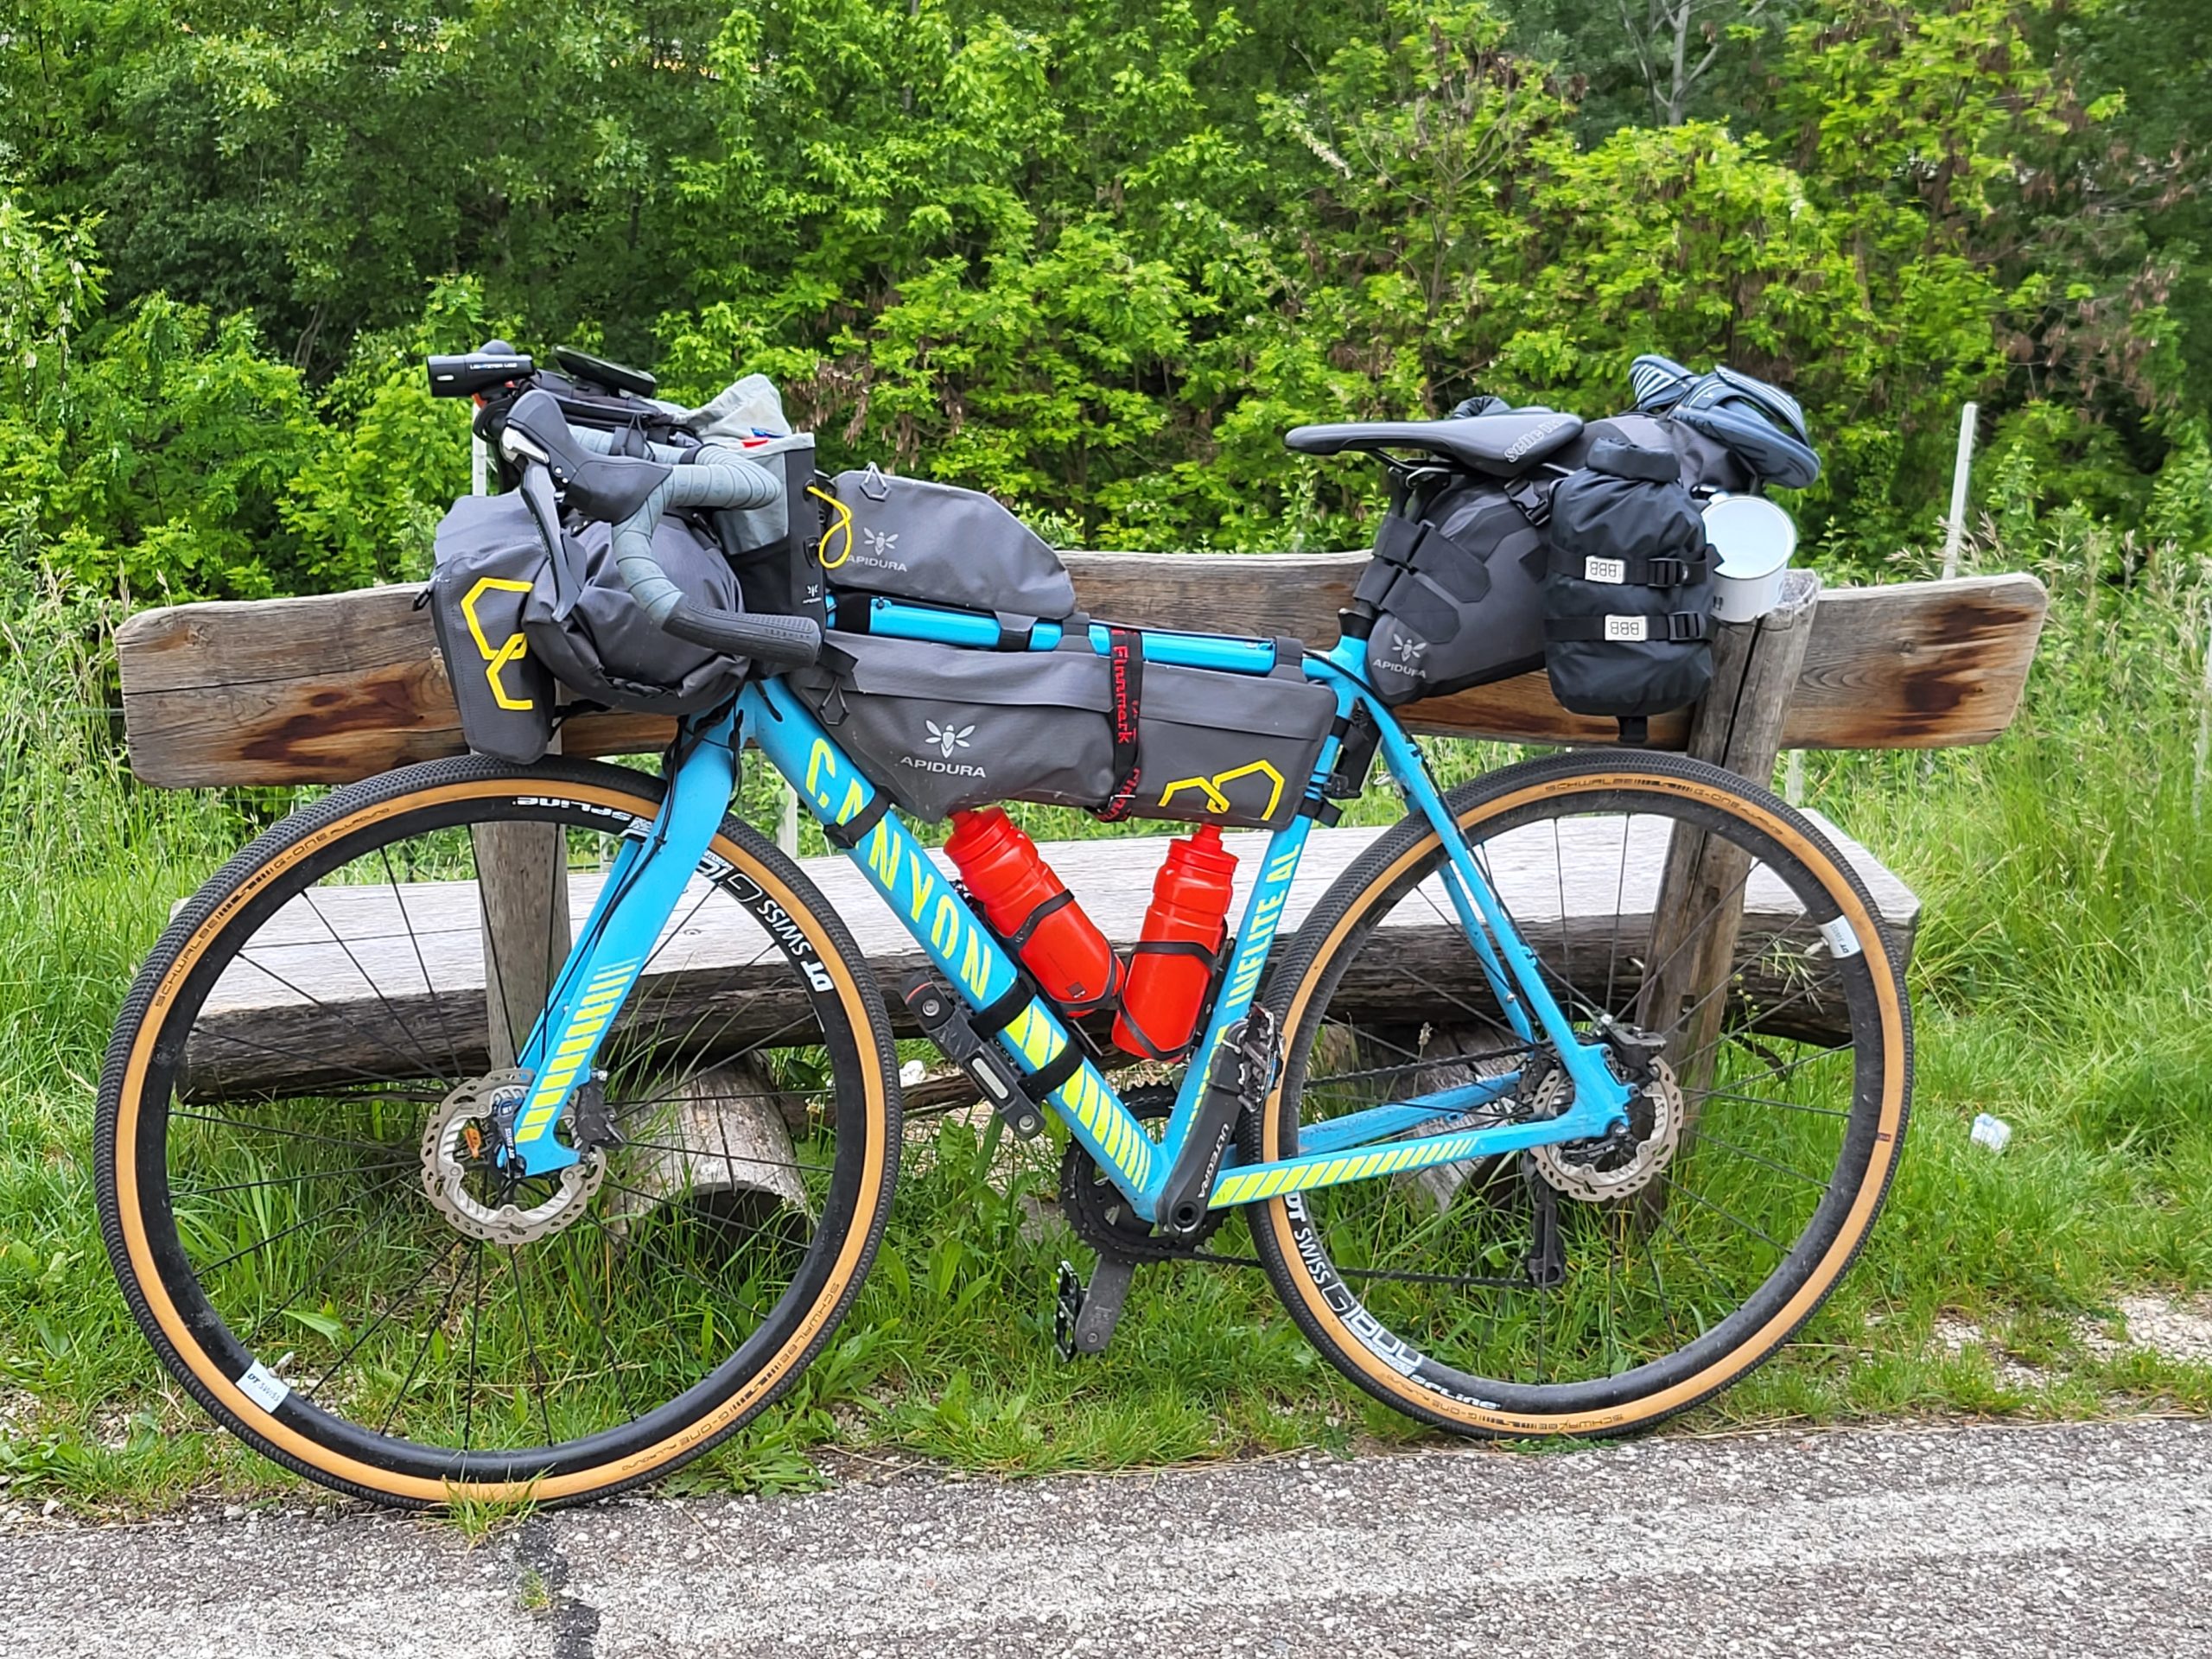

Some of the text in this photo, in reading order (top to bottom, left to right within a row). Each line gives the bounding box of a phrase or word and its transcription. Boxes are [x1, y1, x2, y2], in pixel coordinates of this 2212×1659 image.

[847, 555, 907, 572] APIDURA
[899, 756, 986, 779] APIDURA
[1545, 778, 1633, 791] SCHWALBE
[805, 738, 991, 1001] CANYON
[156, 918, 219, 1007] SCHWALBE
[274, 832, 328, 869] G-ONE
[756, 899, 812, 956] SWISS
[1226, 844, 1301, 1008] INFLITE AL
[800, 961, 835, 992] DT
[1198, 1123, 1230, 1198] ULTEGRA
[1284, 1192, 1306, 1223] DT
[1294, 1227, 1331, 1284] SWISS
[781, 1282, 841, 1363] SCHWALBE
[679, 1411, 729, 1446] G-ONE
